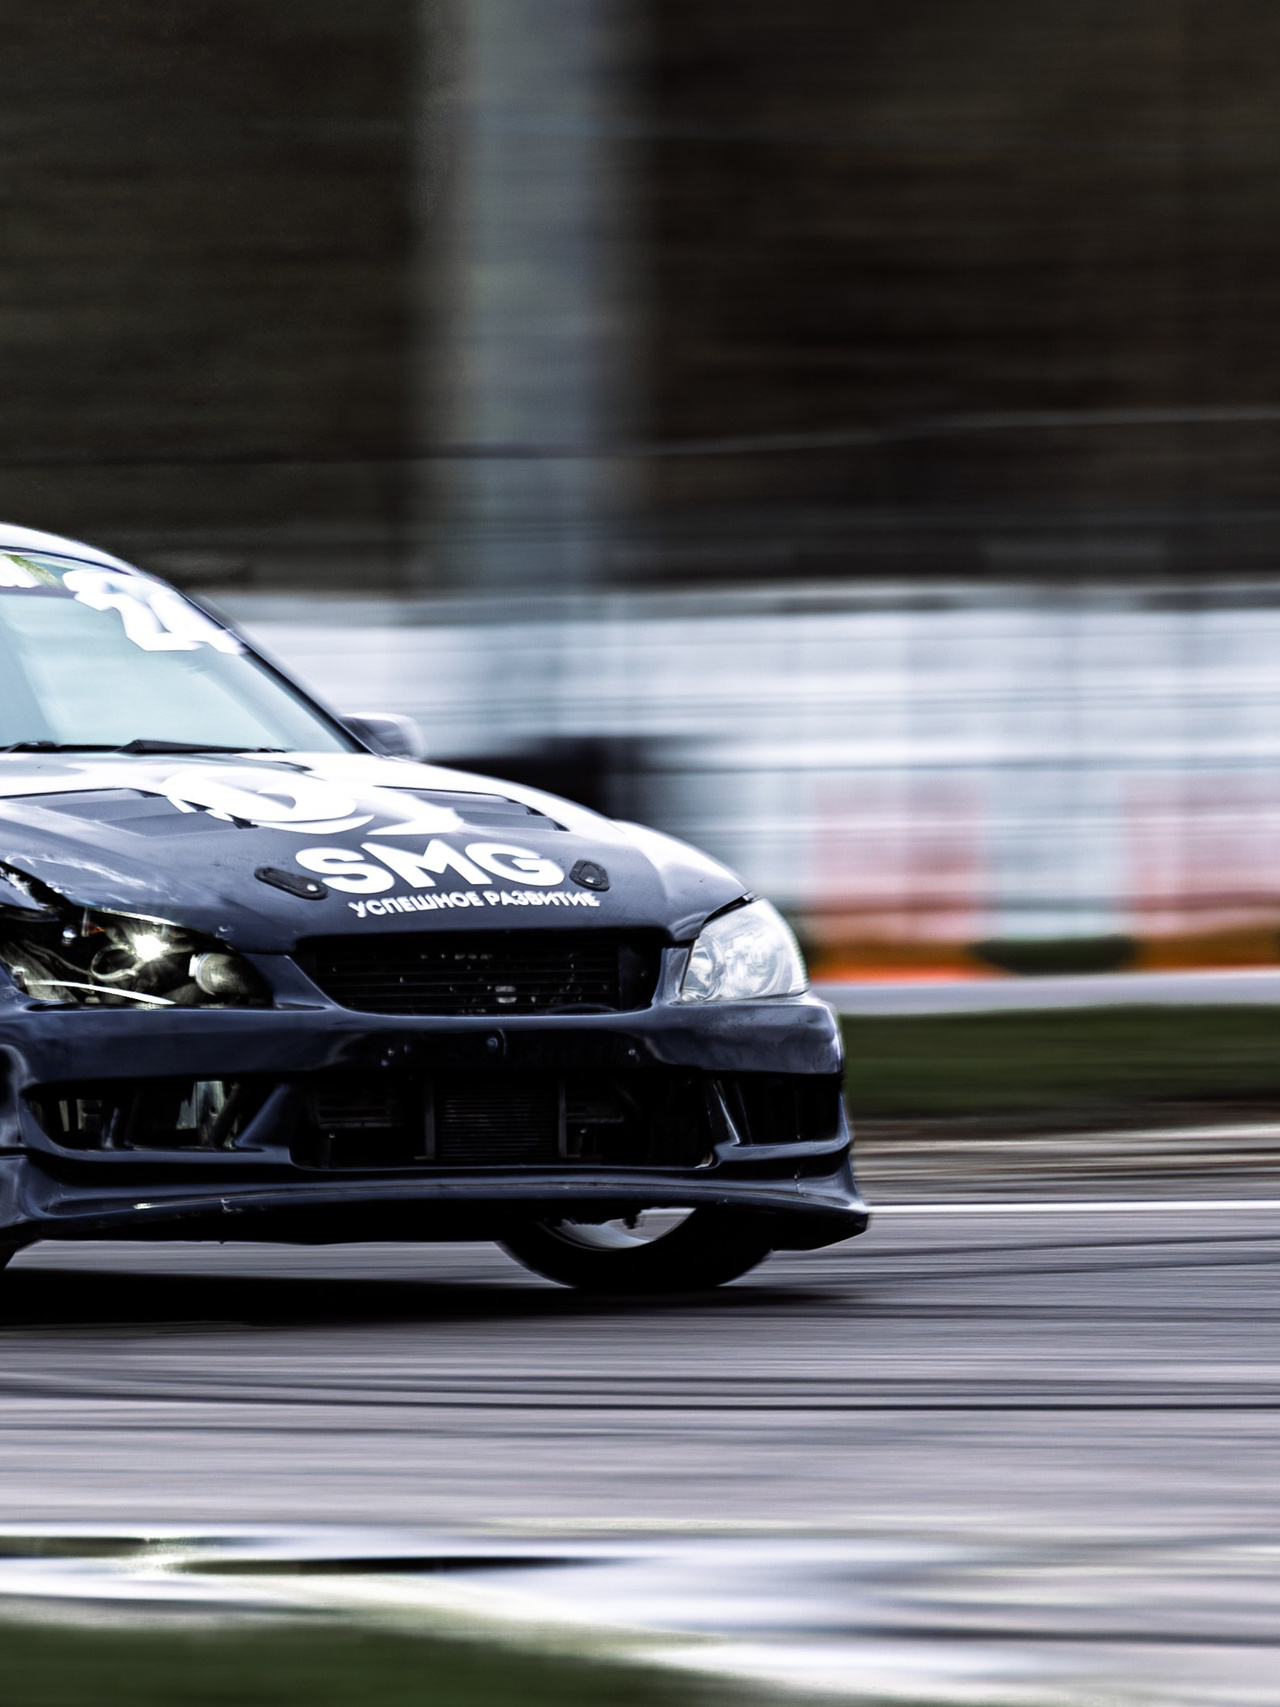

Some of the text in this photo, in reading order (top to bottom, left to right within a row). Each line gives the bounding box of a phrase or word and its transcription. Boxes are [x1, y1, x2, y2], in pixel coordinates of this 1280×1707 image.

[295, 838, 565, 894] SMG
[348, 889, 601, 918] УСПЕШНОЕ РАЗВИТИЕ
